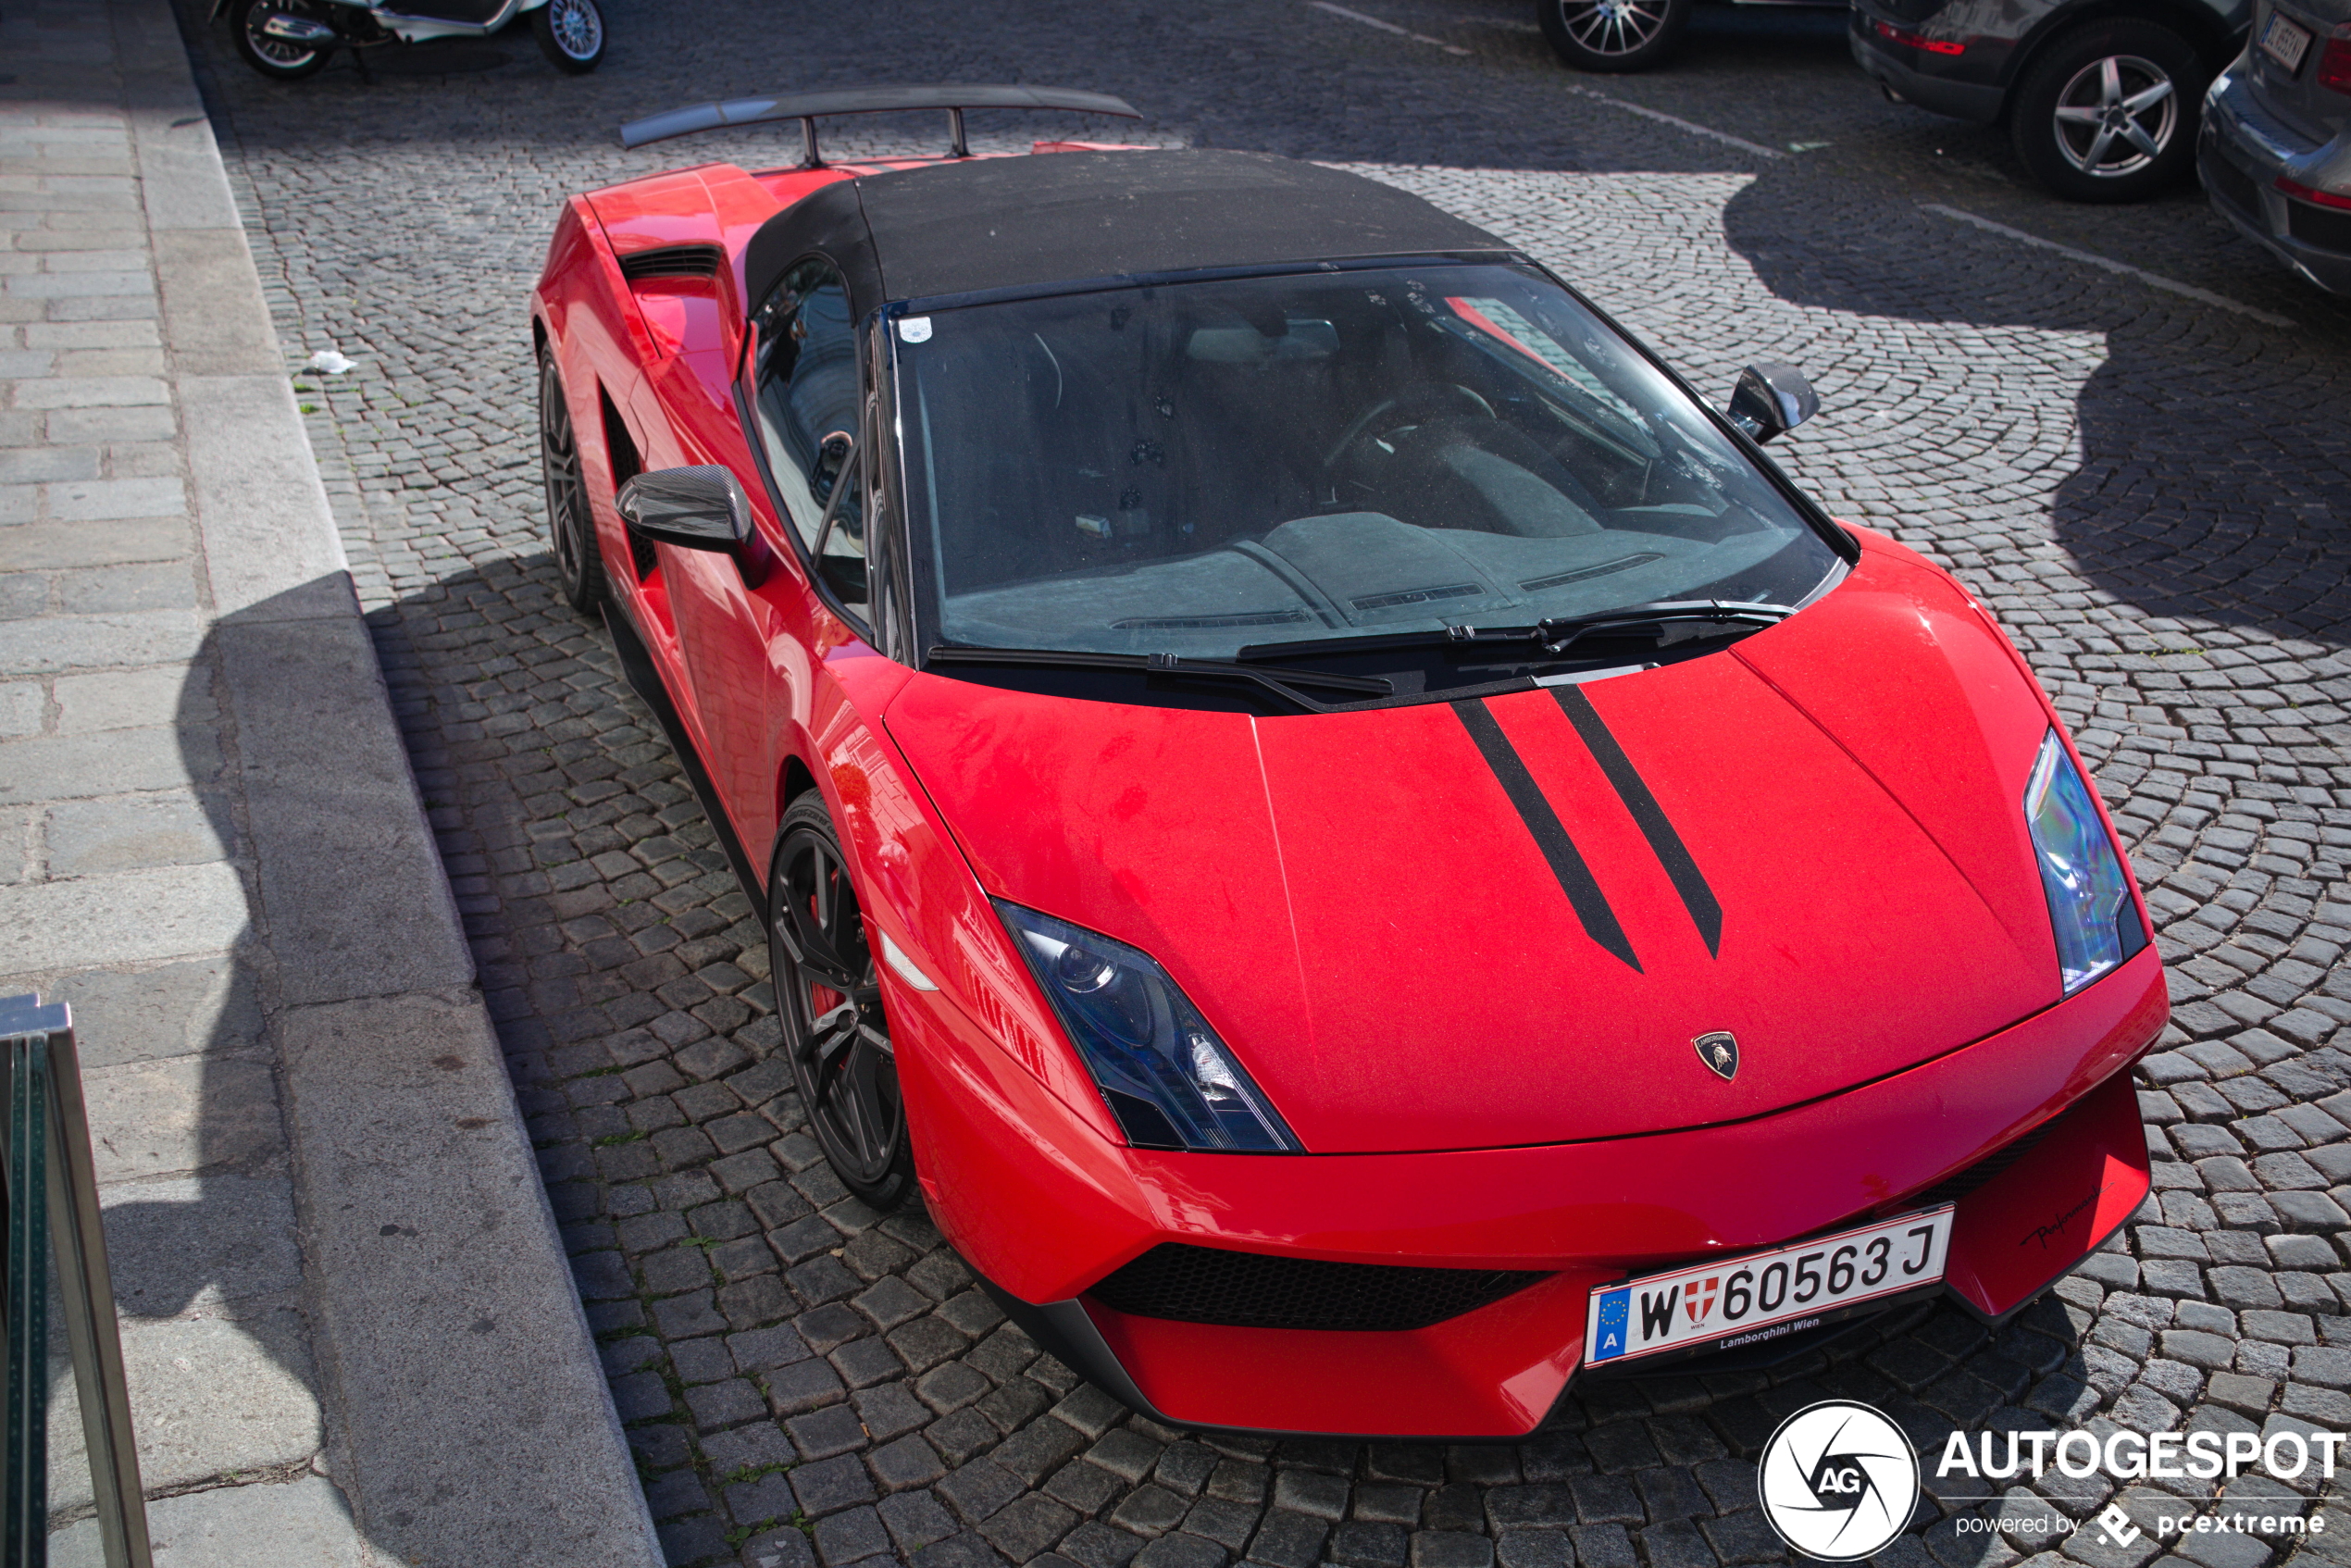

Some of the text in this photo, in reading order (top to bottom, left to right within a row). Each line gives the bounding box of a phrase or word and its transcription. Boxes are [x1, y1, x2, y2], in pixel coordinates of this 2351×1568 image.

[1697, 1034, 1733, 1048] LAMBORGHINI
[2019, 1181, 2116, 1250] Performante
[1641, 1224, 1934, 1341] W 60563 J
[1690, 1322, 1705, 1330] WIEN
[1720, 1317, 1820, 1350] Lamborghini Wien
[1603, 1332, 1618, 1350] A
